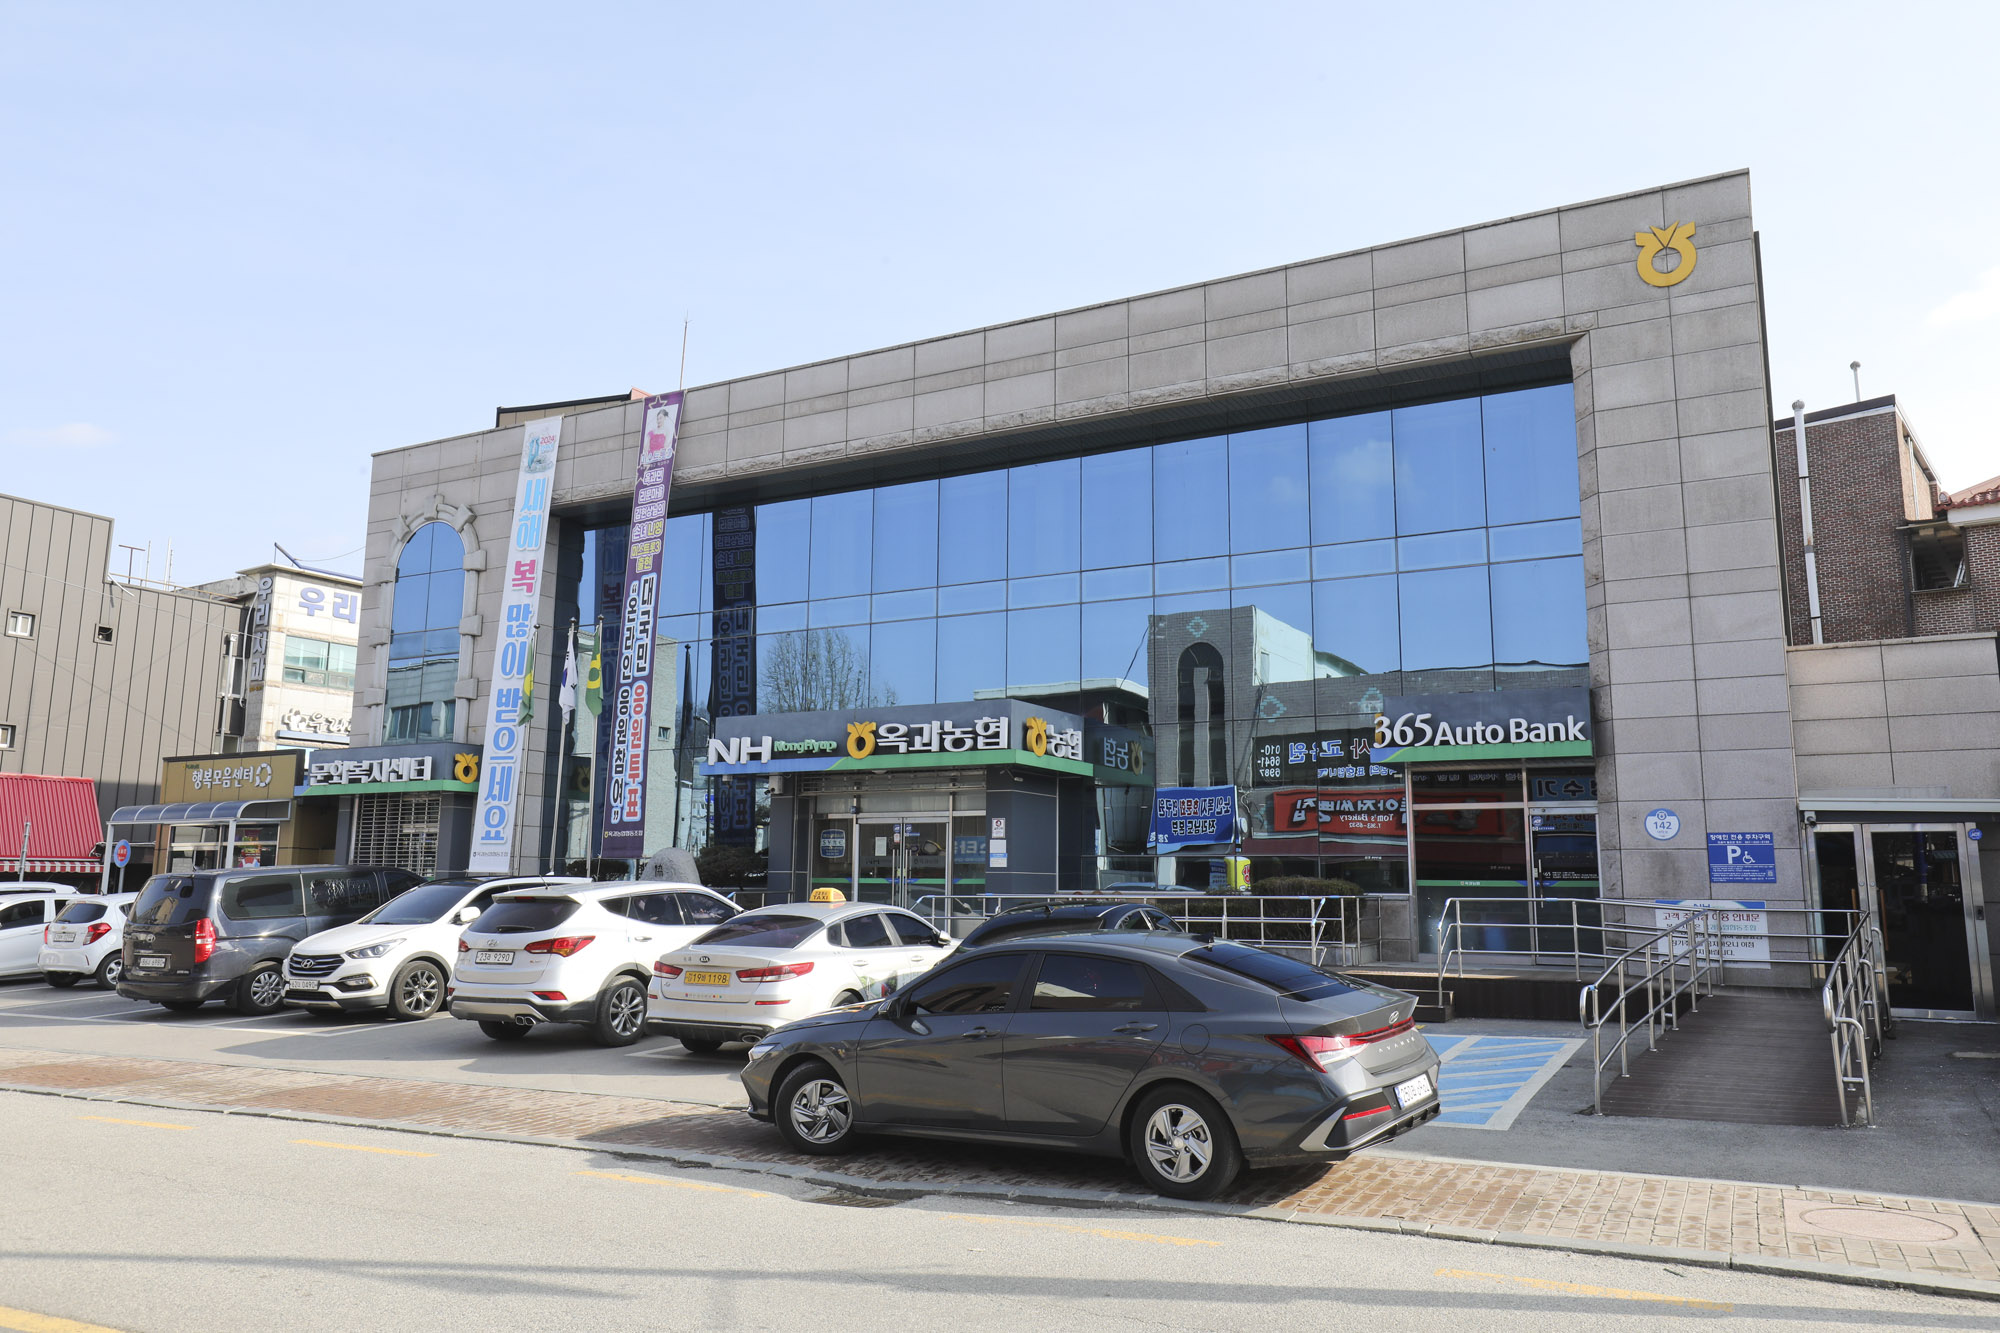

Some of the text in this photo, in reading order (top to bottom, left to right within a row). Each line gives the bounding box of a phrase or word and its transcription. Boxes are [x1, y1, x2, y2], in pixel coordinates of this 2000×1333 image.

[516, 477, 546, 548] 새해
[511, 559, 537, 594] 복
[299, 587, 358, 624] 우리
[501, 603, 532, 677] 많이
[877, 716, 1008, 753] 옥과농협
[1047, 724, 1083, 761] 농협
[1509, 715, 1587, 743] Bank
[481, 688, 524, 841] 받으세요
[708, 736, 837, 766] NH NongHyup
[192, 766, 253, 790] 행복모음센터
[309, 755, 432, 786] 문화복지센터
[1653, 821, 1672, 830] 142
[1726, 845, 1742, 864] P
[1732, 913, 1760, 922] 안내문
[493, 953, 510, 962] 9290
[708, 974, 727, 984] 1198
[1378, 1036, 1416, 1053] AVANTE
